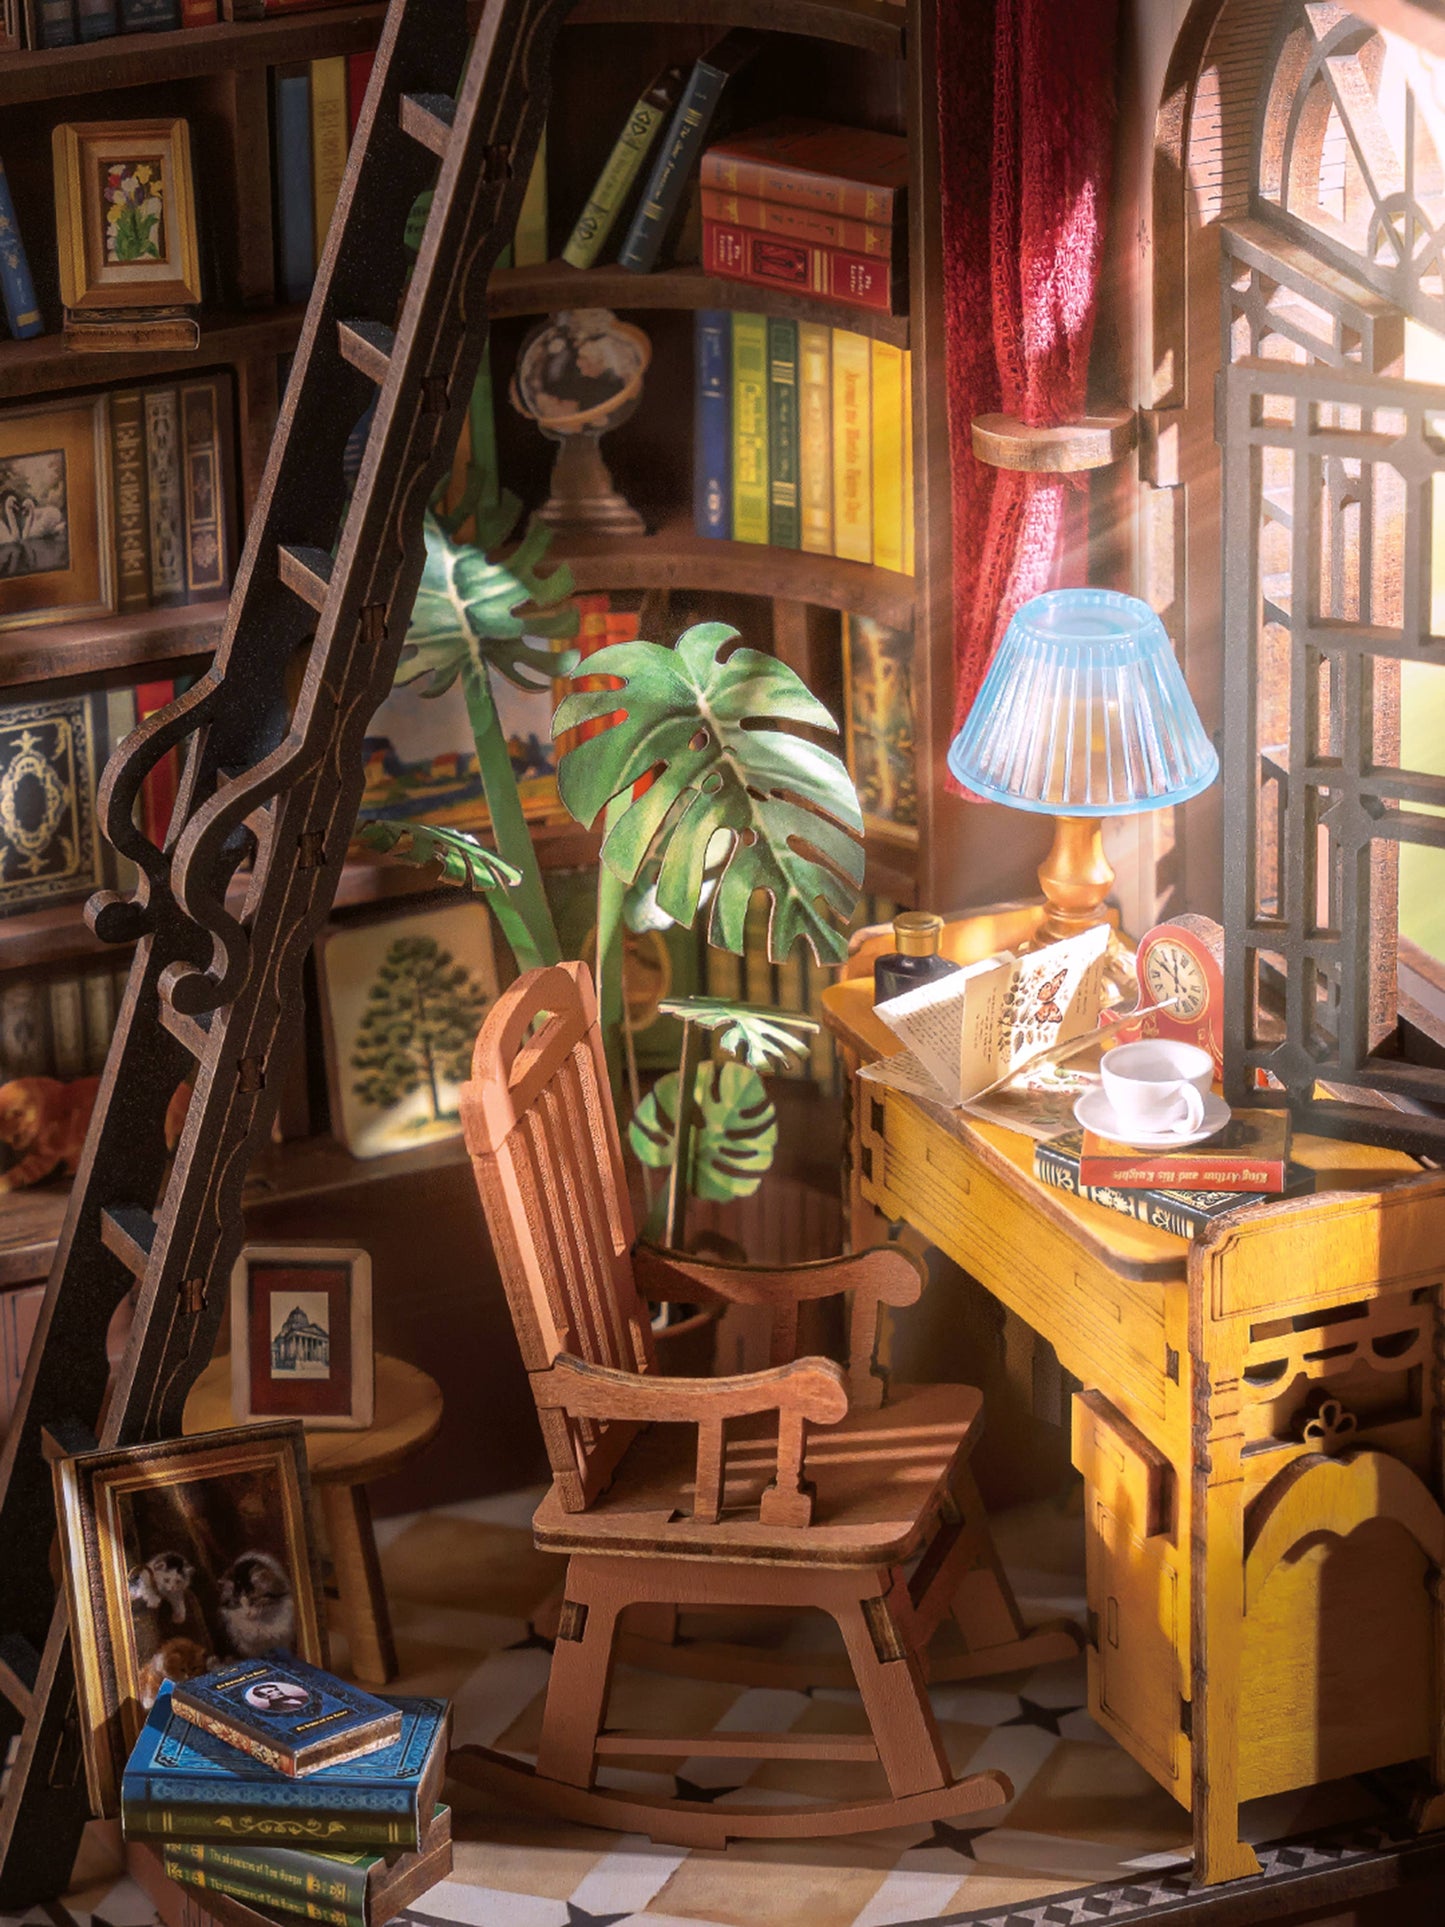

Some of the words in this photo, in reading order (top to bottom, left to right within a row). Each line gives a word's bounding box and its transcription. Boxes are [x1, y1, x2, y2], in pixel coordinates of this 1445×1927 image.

[1158, 1171, 1175, 1182] His
[1179, 1171, 1199, 1181] and
[1203, 1172, 1239, 1183] Arthur
[1242, 1169, 1268, 1184] King
